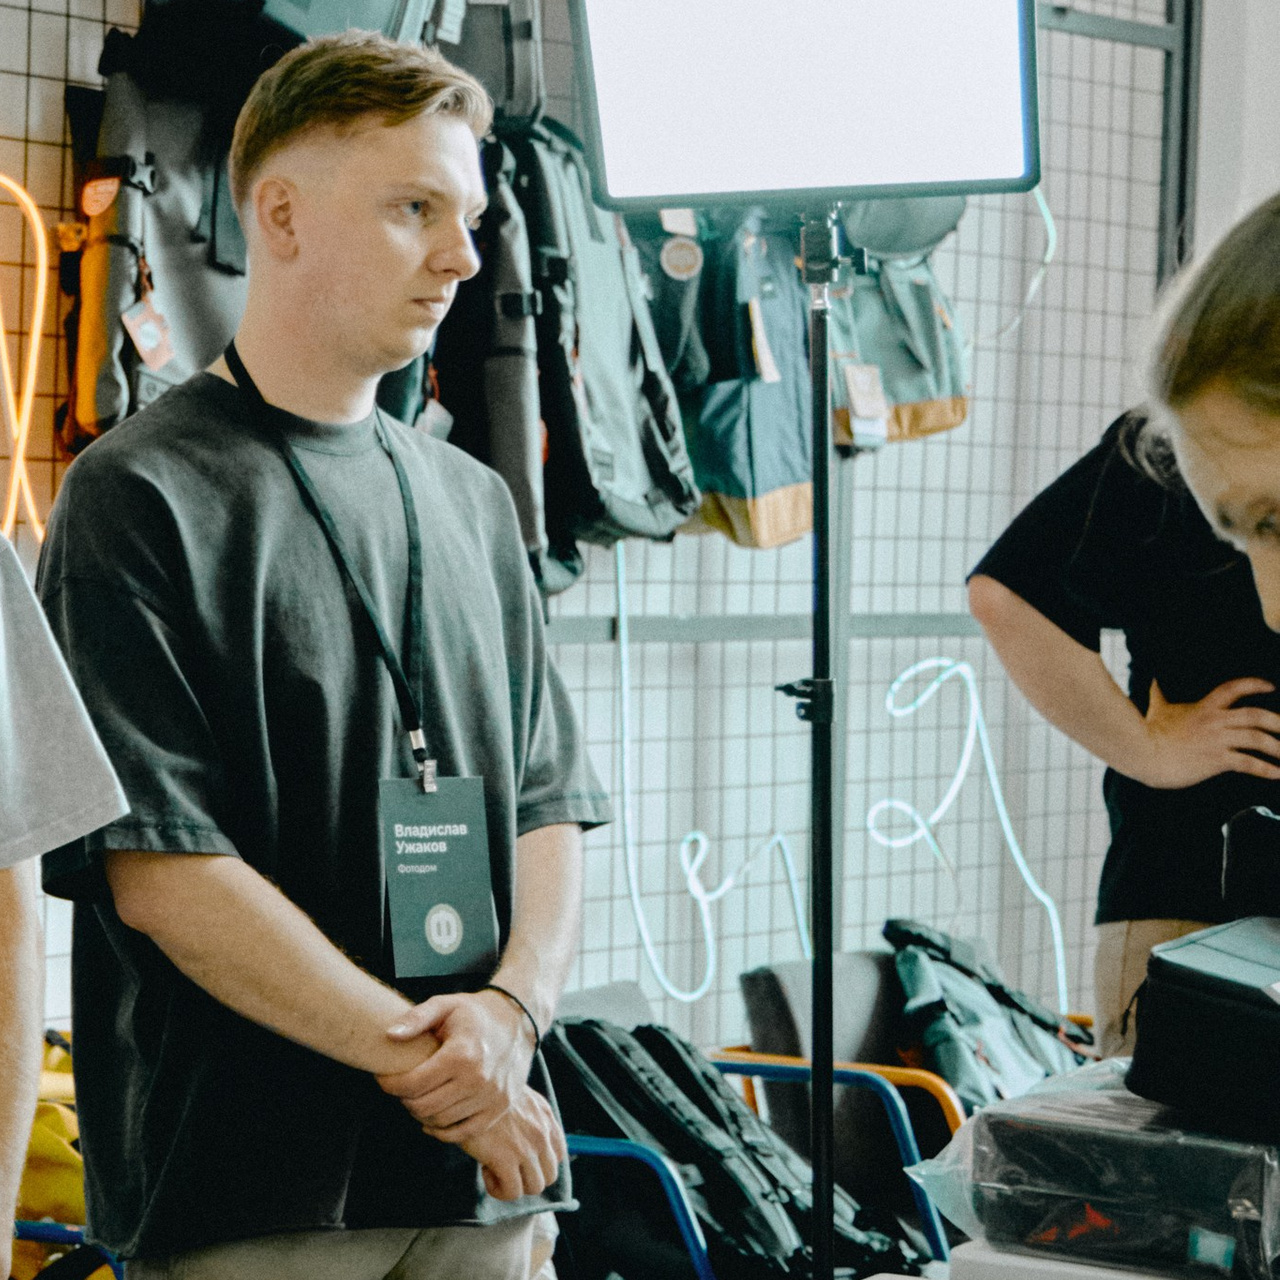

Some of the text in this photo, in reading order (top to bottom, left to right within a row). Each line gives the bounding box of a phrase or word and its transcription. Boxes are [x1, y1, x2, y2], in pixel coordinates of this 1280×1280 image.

[394, 823, 468, 838] Владислав
[396, 840, 447, 854] Ужаков
[397, 863, 437, 874] Фотодом
